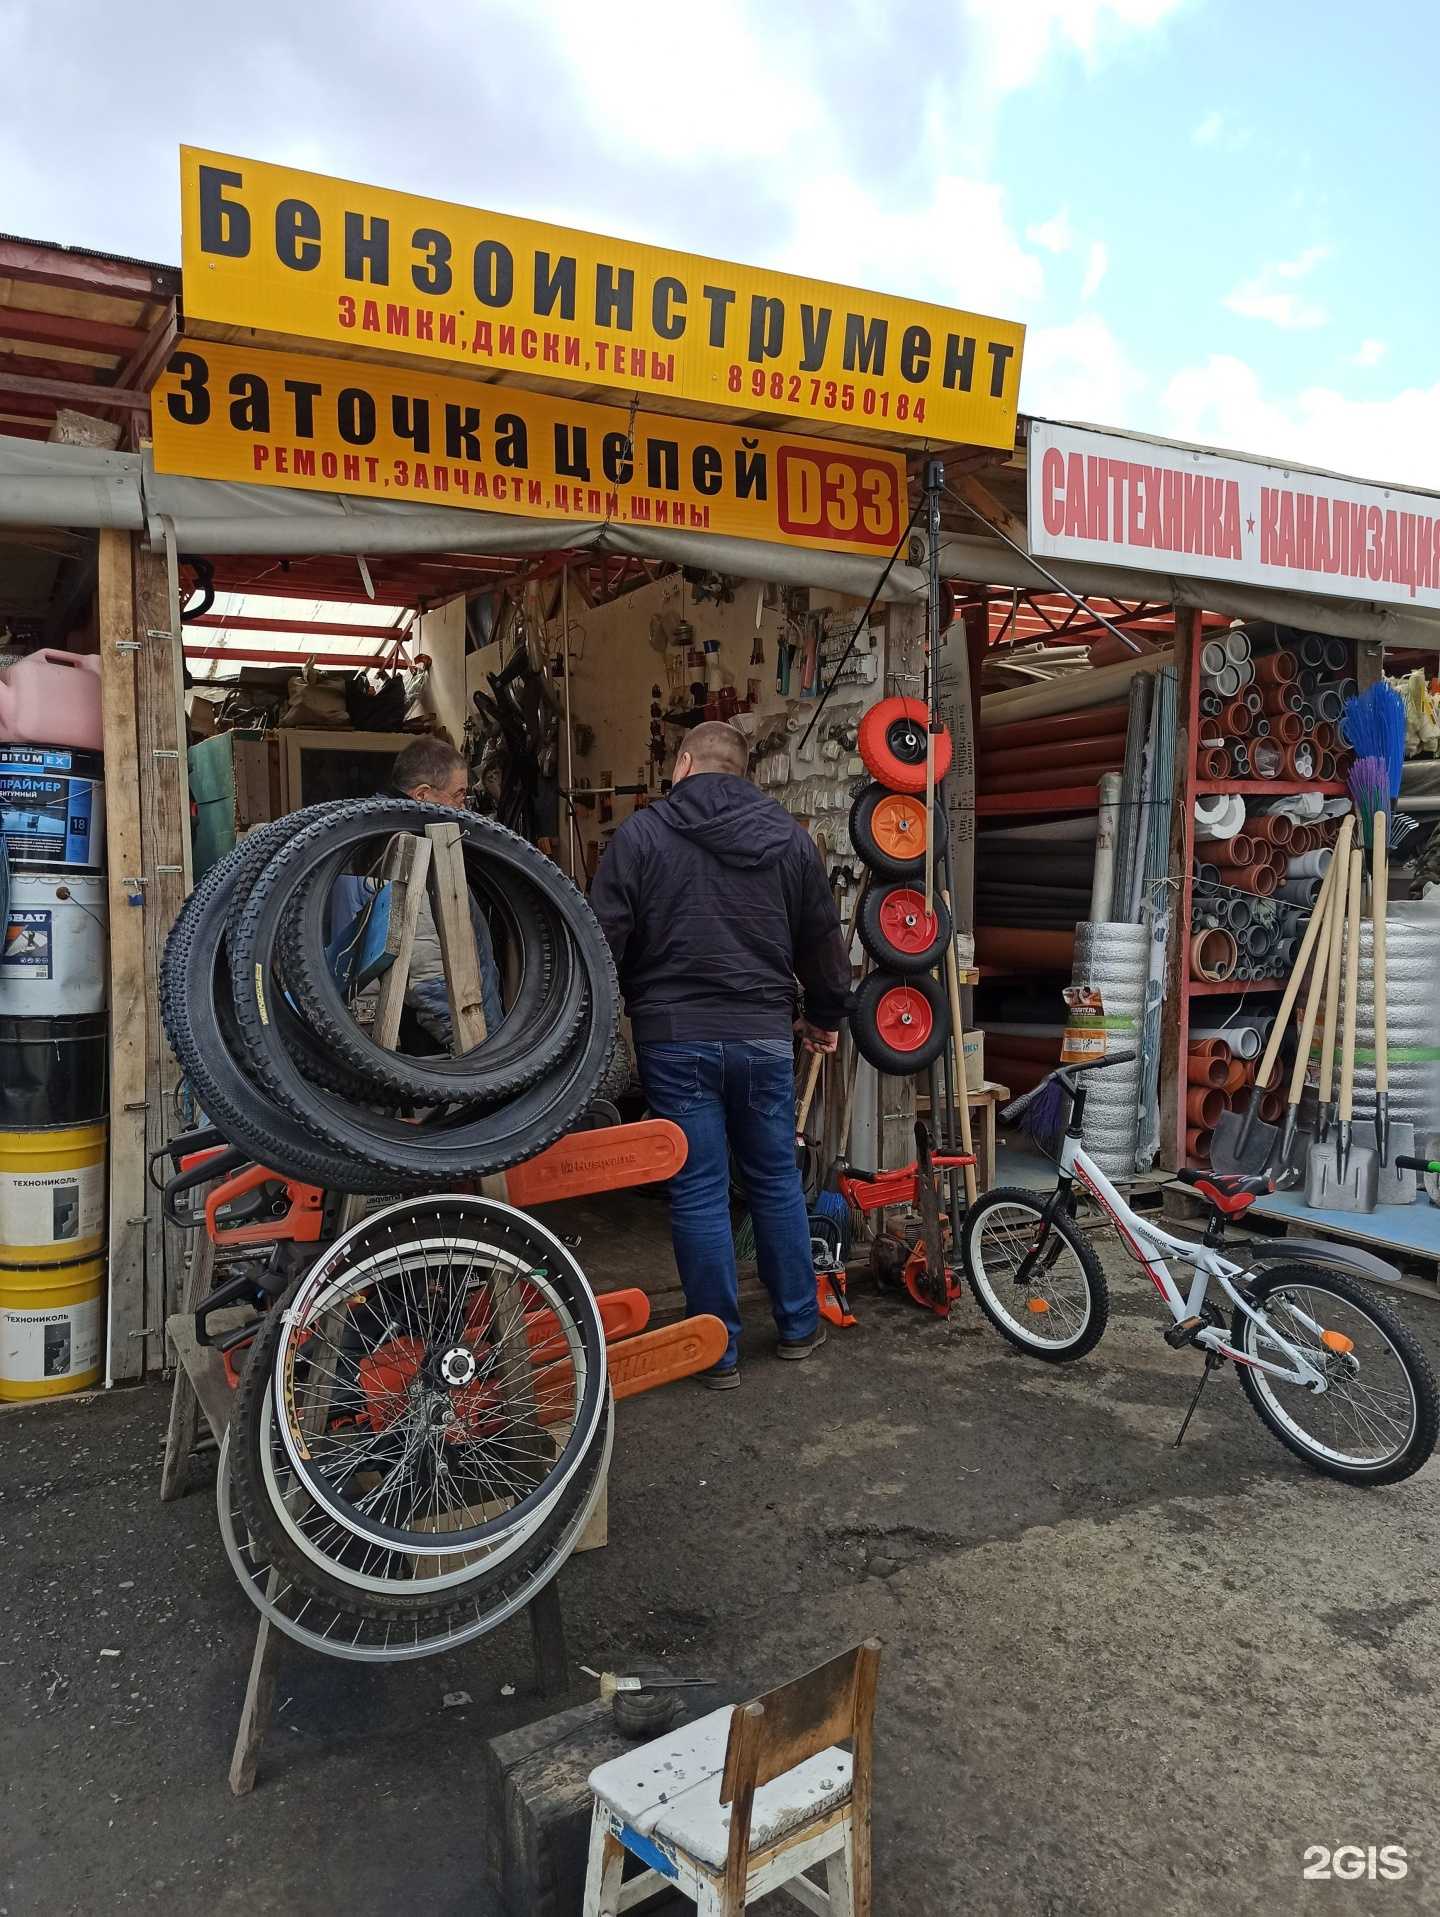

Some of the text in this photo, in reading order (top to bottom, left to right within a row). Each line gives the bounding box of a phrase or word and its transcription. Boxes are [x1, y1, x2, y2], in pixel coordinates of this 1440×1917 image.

[199, 165, 1013, 398] Бензоинструмент
[166, 351, 768, 500] Заточка цепей
[786, 456, 894, 536] D33
[1042, 447, 1243, 560] САНТЕХНИКА
[73, 819, 86, 830] 18
[13, 1177, 78, 1188] ТЕХНОНИКОЛЬ
[1138, 1226, 1169, 1249] COMANCHE
[7, 1313, 69, 1324] ТЕХНОНИКОЛЬ
